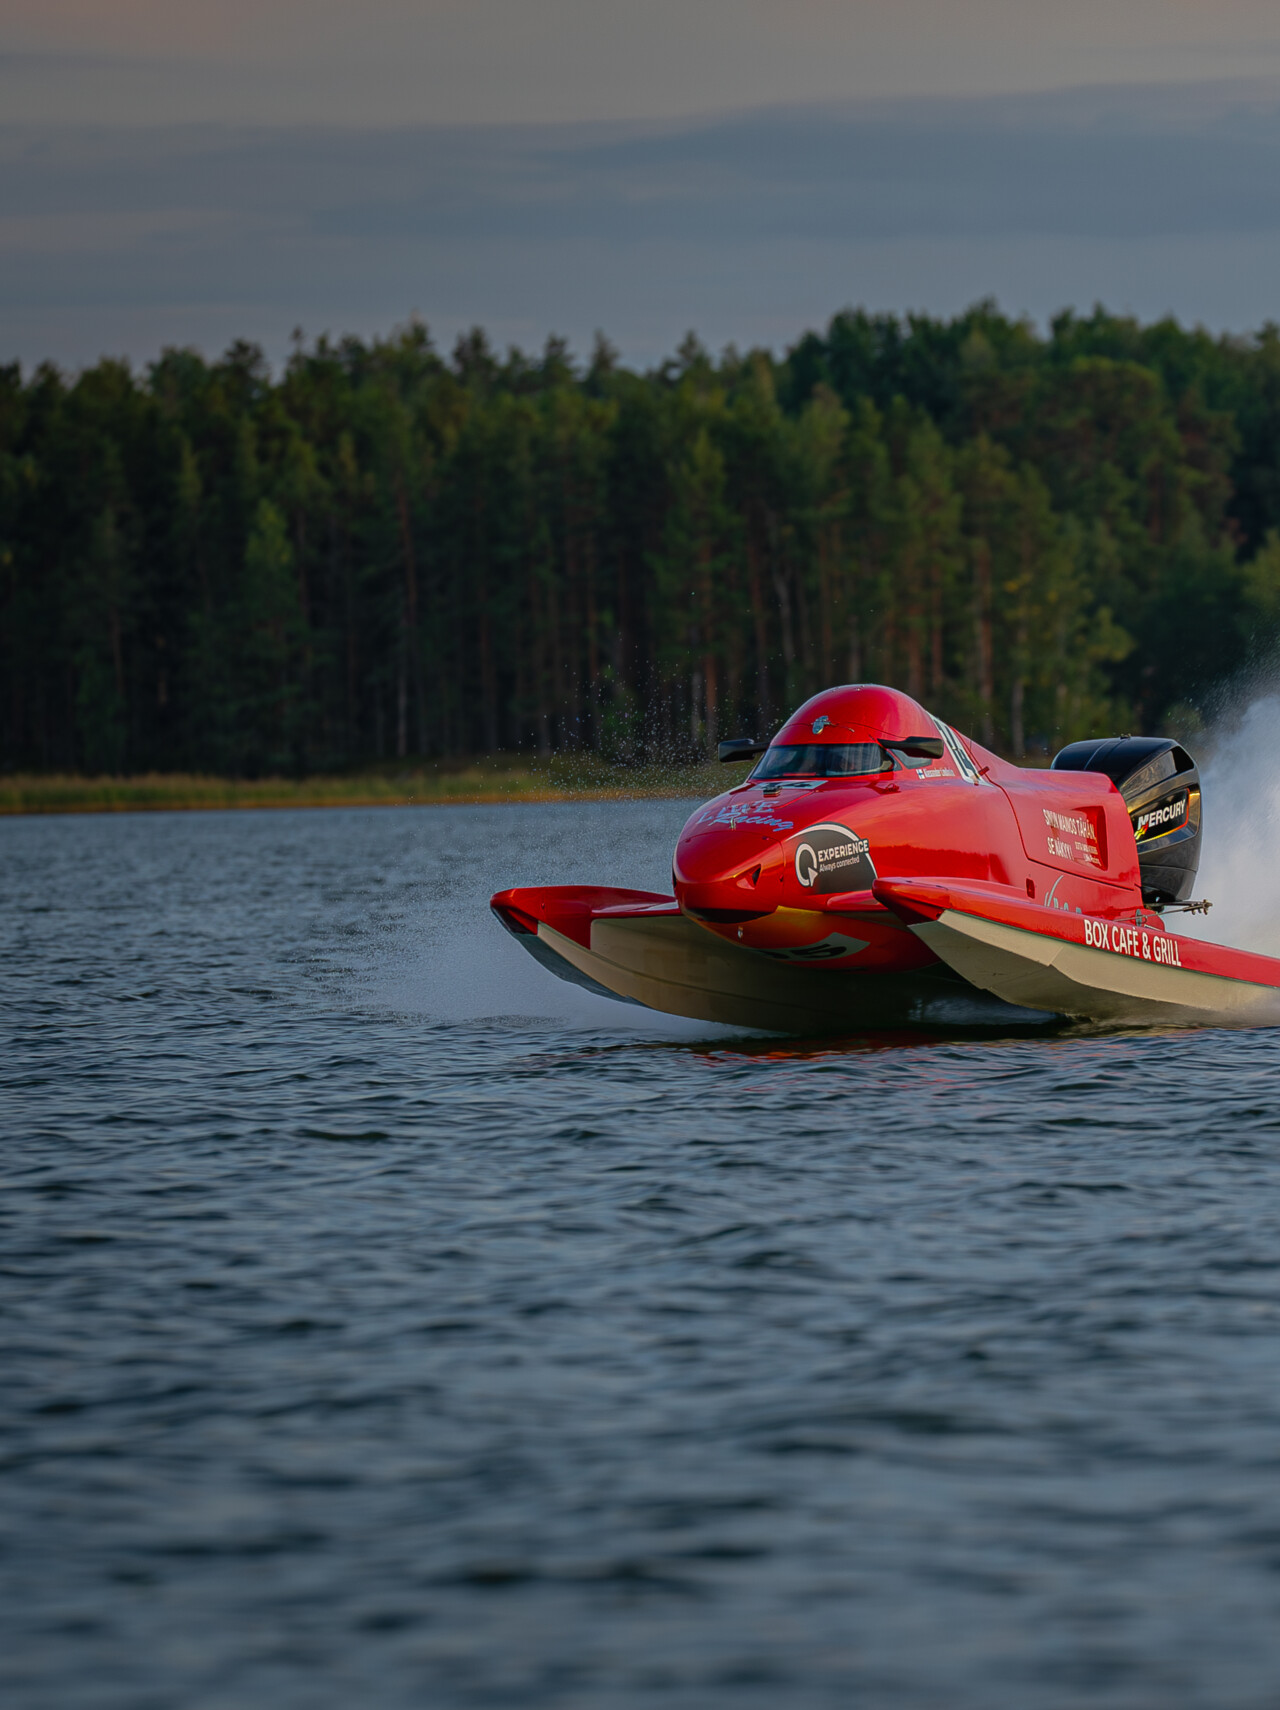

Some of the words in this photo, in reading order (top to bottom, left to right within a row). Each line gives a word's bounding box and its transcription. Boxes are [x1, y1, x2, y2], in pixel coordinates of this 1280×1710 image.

[1136, 799, 1186, 832] MERCURY
[818, 839, 869, 862] EXPERIENCE
[1047, 836, 1055, 855] SE
[819, 862, 836, 873] Always
[836, 855, 860, 868] connected
[1084, 919, 1110, 950] BOX
[1142, 932, 1151, 960] &
[1153, 936, 1182, 966] GRILL
